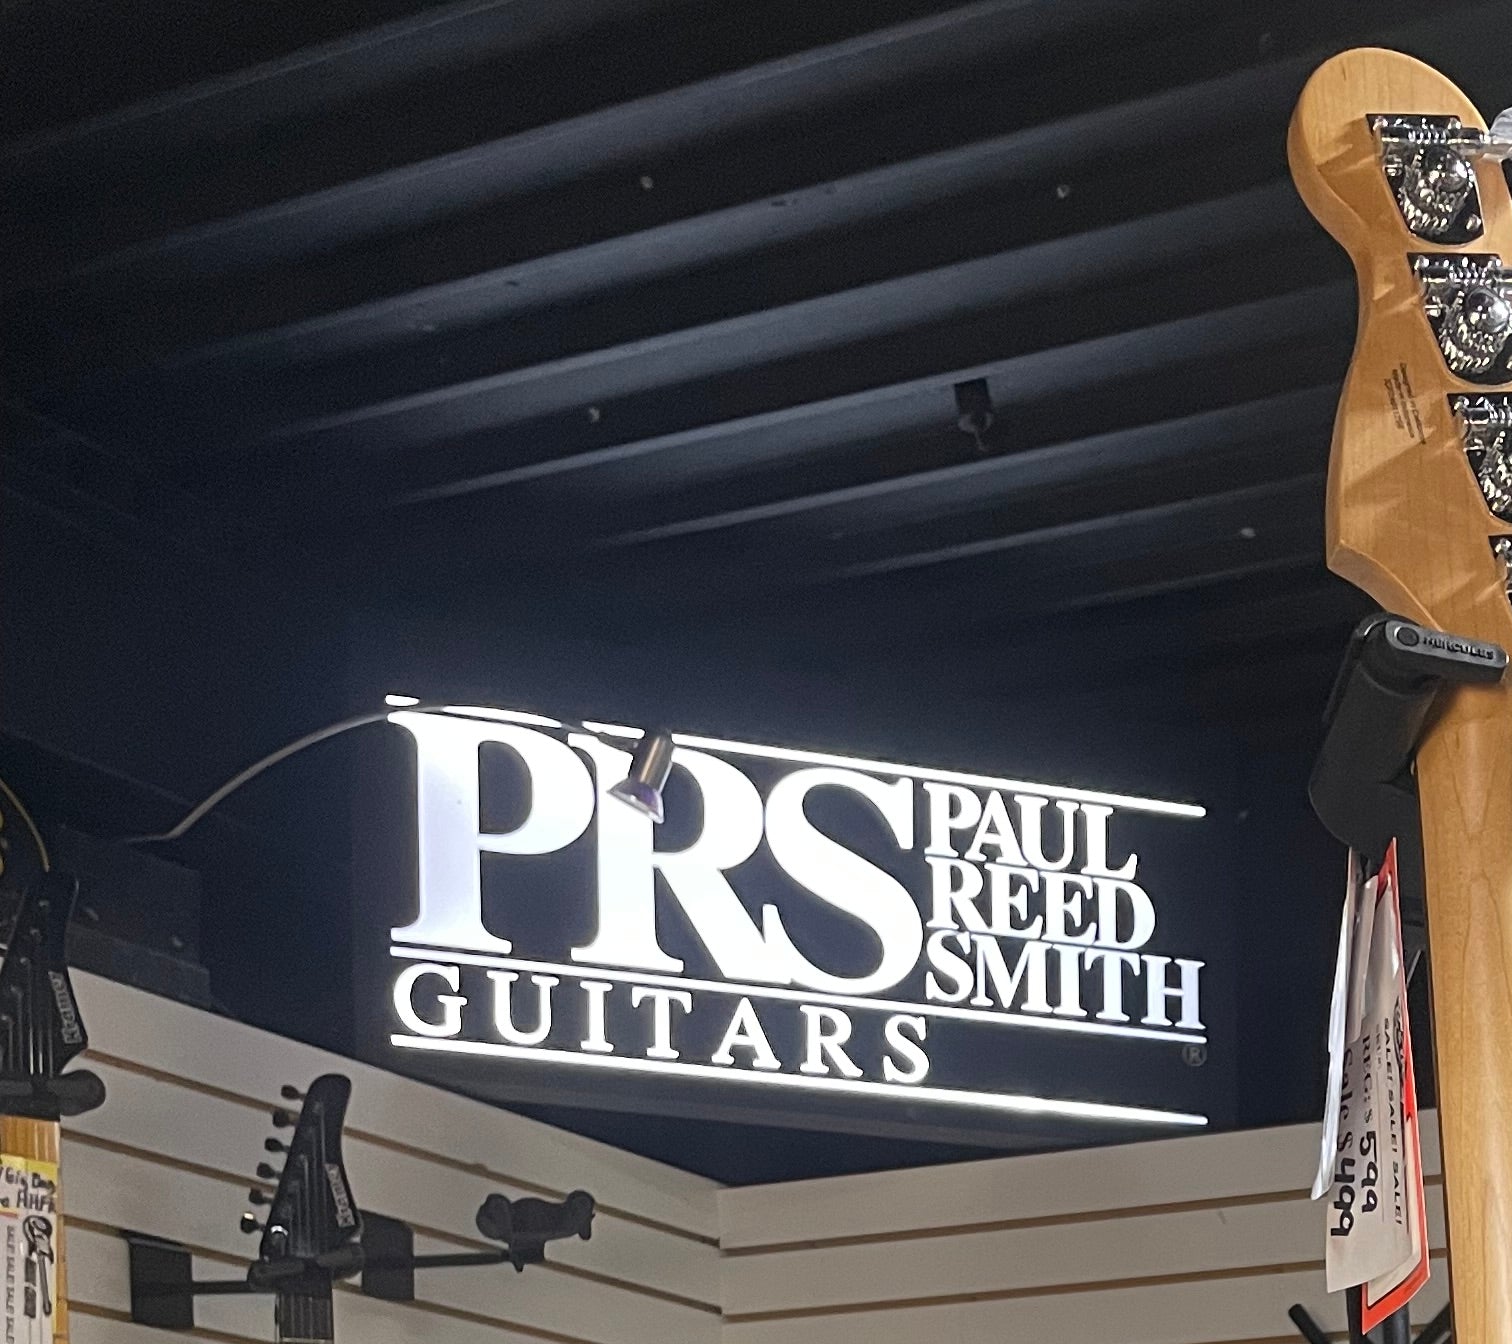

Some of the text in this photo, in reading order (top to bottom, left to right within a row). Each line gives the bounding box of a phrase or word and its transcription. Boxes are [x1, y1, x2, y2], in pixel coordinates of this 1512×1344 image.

[387, 711, 923, 995] PRS
[923, 779, 1138, 881] PAUL
[925, 855, 1156, 952] REED
[391, 962, 931, 1084] GUITARS
[925, 931, 1207, 1031] SMITH
[1387, 1088, 1398, 1153] SALE!
[1392, 1161, 1402, 1225] SALE!
